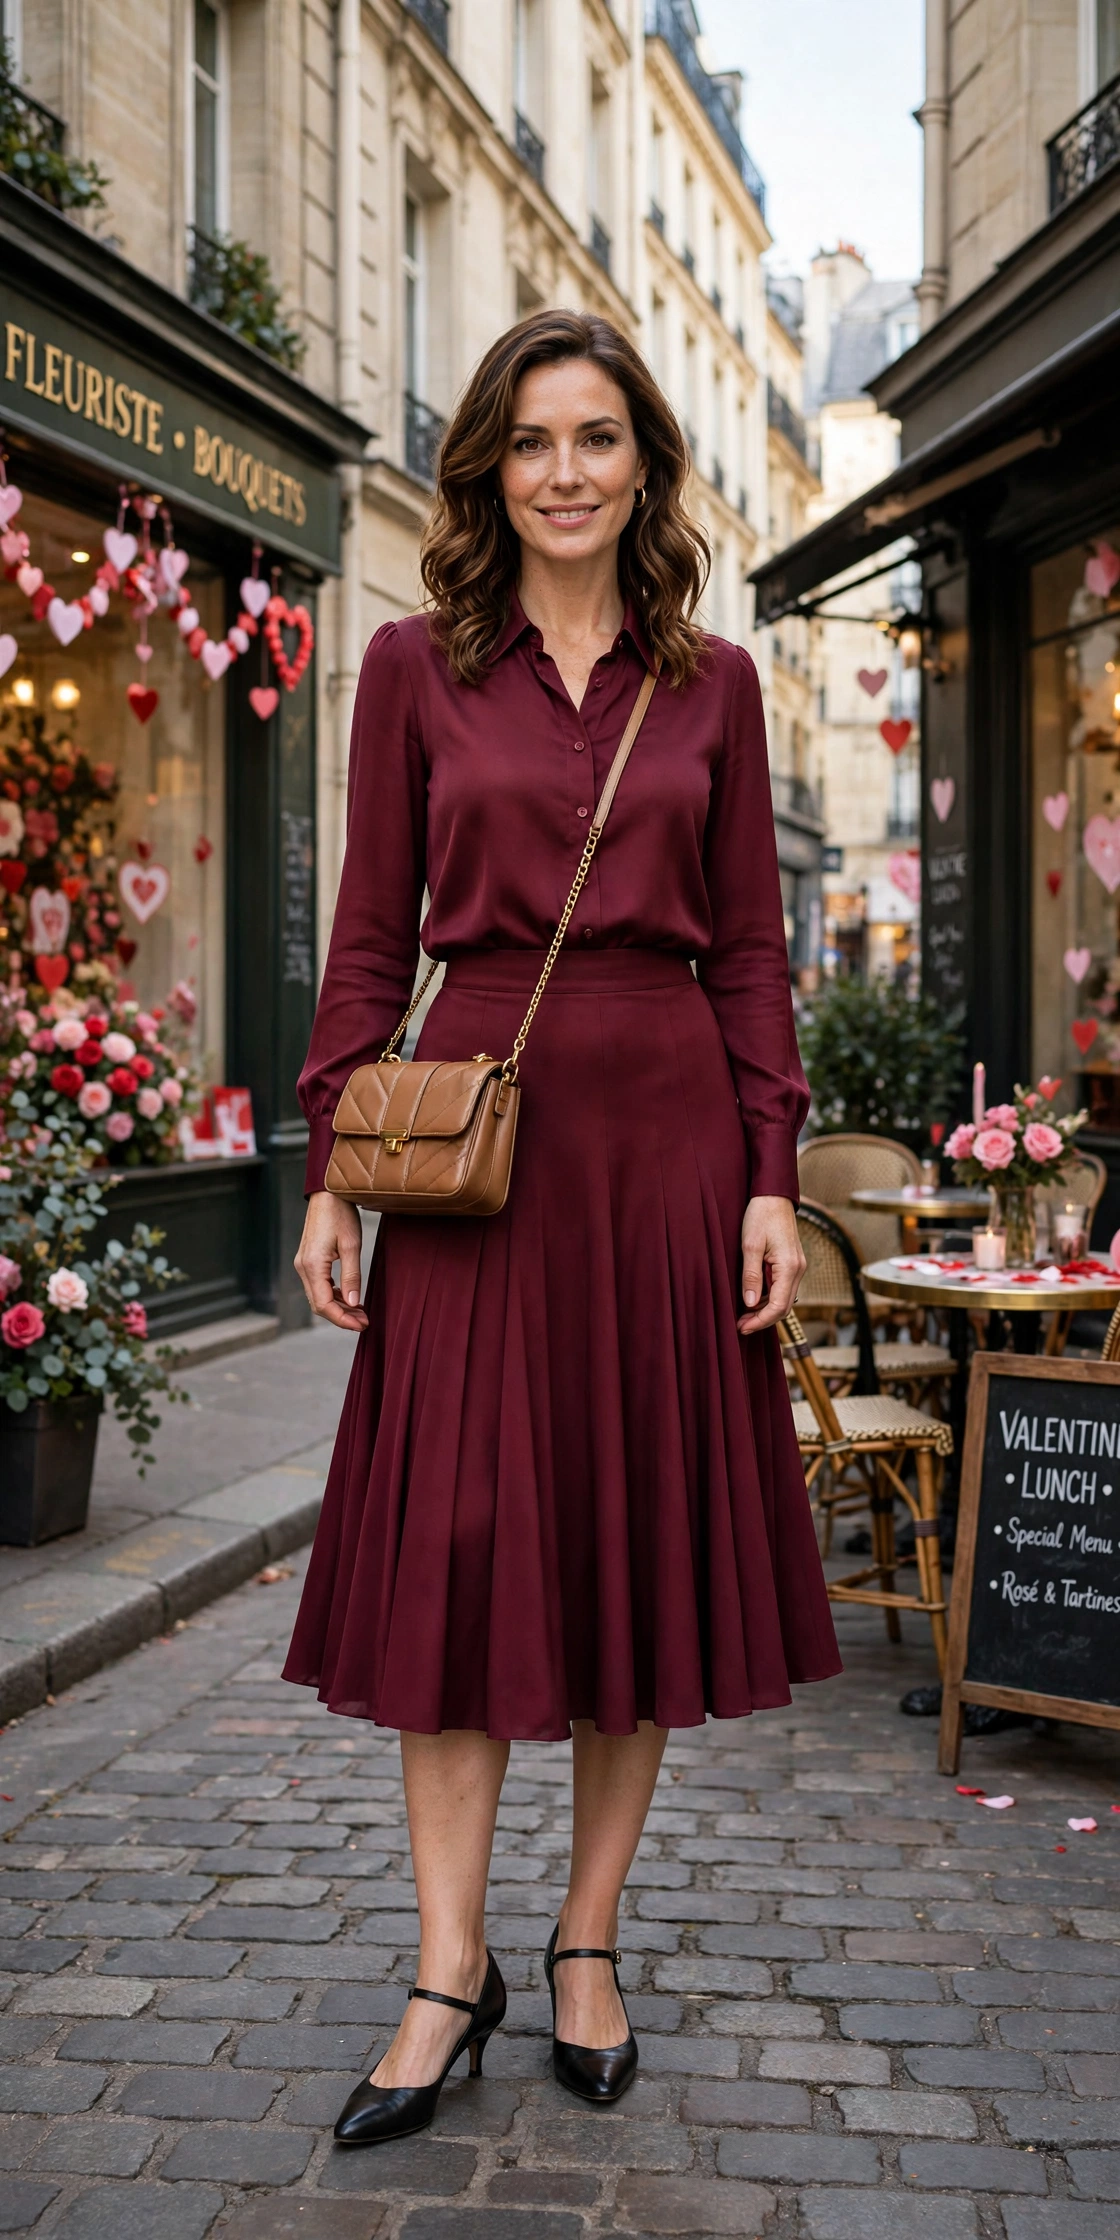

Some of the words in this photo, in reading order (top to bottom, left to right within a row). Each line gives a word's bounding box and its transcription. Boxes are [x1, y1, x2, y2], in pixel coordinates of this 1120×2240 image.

[4, 321, 163, 455] FLEURISTE
[193, 425, 306, 526] BOUQUETS
[1021, 1461, 1097, 1505] LUNCH
[1006, 1516, 1063, 1553] Special
[1069, 1525, 1113, 1554] Menu
[1002, 1570, 1039, 1607] Rosé
[1044, 1581, 1056, 1604] &
[1061, 1579, 1120, 1613] Tartines
